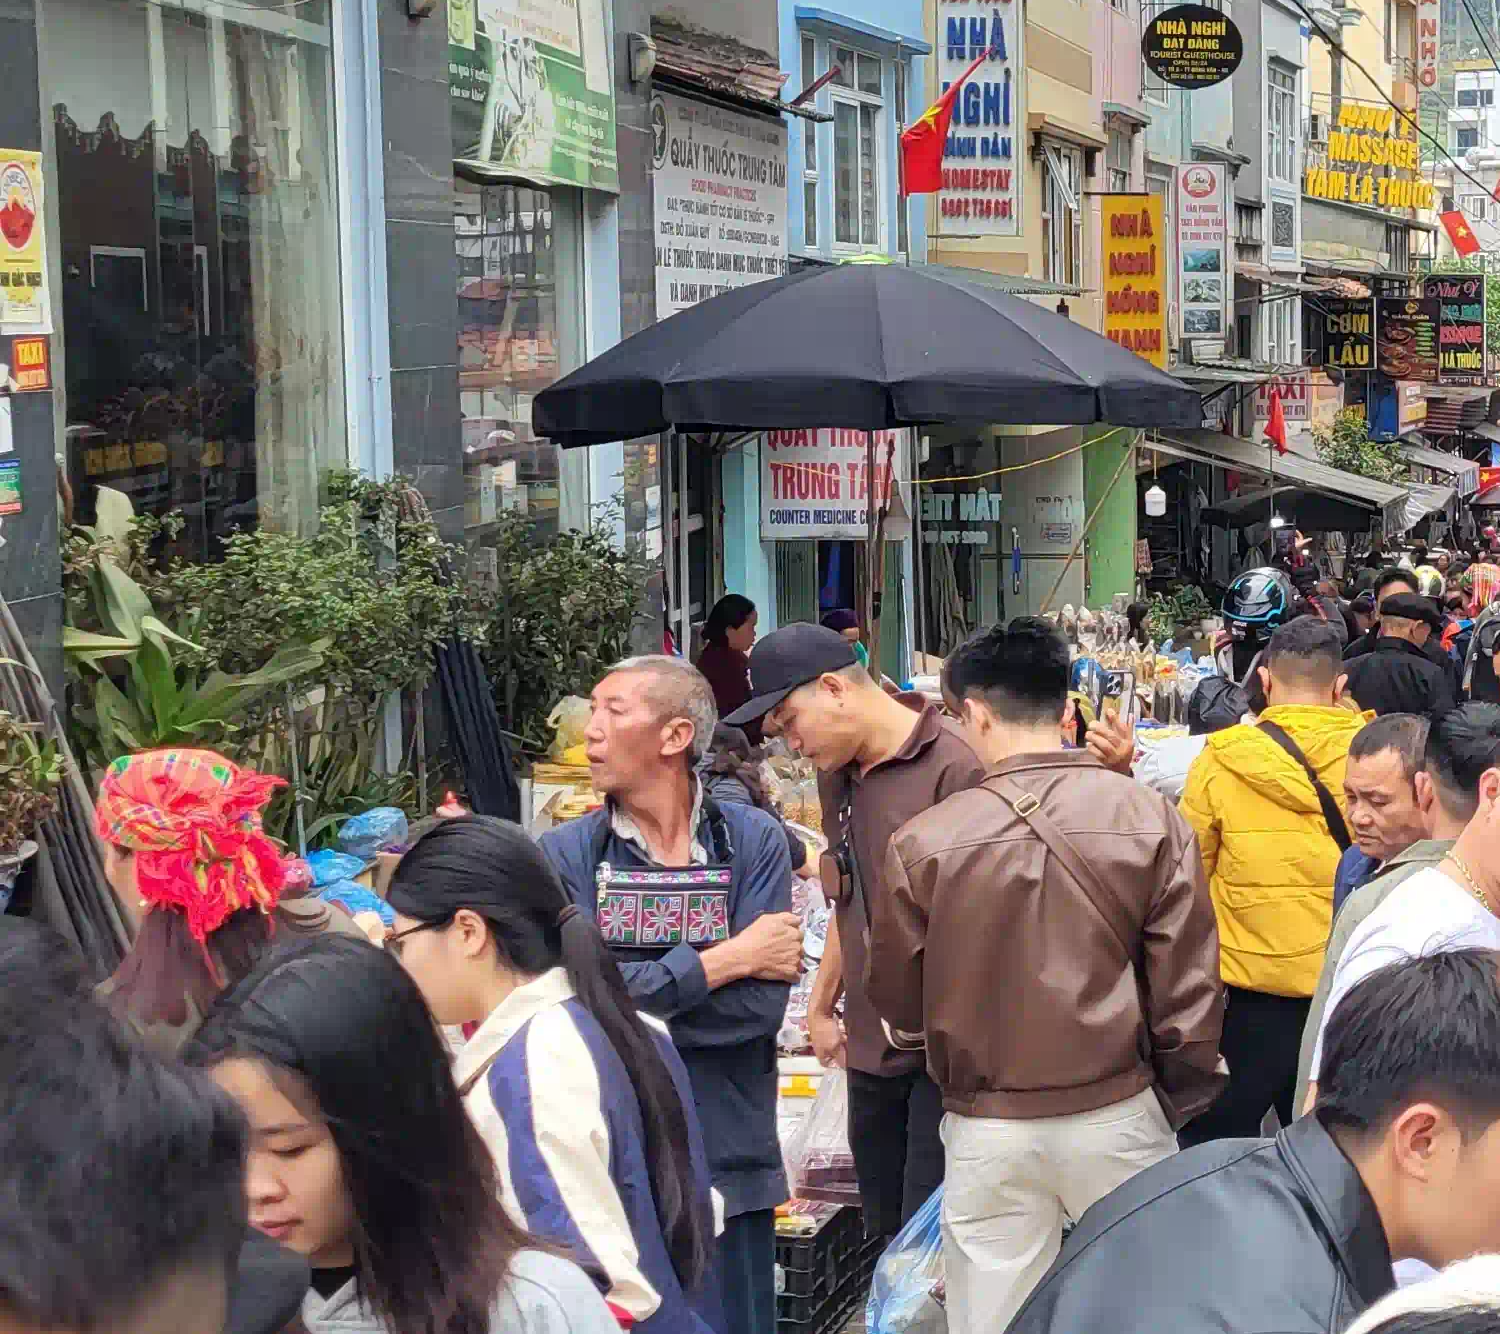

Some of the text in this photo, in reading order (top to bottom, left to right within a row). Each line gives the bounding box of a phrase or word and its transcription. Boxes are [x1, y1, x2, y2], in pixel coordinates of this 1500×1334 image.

[947, 8, 1008, 62] NHÀ
[1156, 16, 1227, 36] NHÀ NGHỈ
[1150, 50, 1237, 60] TOURIST GUESTHOUSE
[942, 67, 1012, 128] NGHỈ
[702, 138, 737, 180] THUỐC
[737, 153, 767, 186] TRUNG
[1327, 130, 1418, 171] MASSAGE
[943, 167, 1012, 192] HOMESTAY
[1110, 207, 1154, 239] NHÀ
[1108, 243, 1157, 279] NGHỈ
[1326, 313, 1370, 335] CƠM
[1328, 336, 1370, 366] LẨU
[769, 462, 841, 501] TRUNG
[769, 509, 811, 525] COUNTER
[813, 509, 858, 525] MEDICINE
